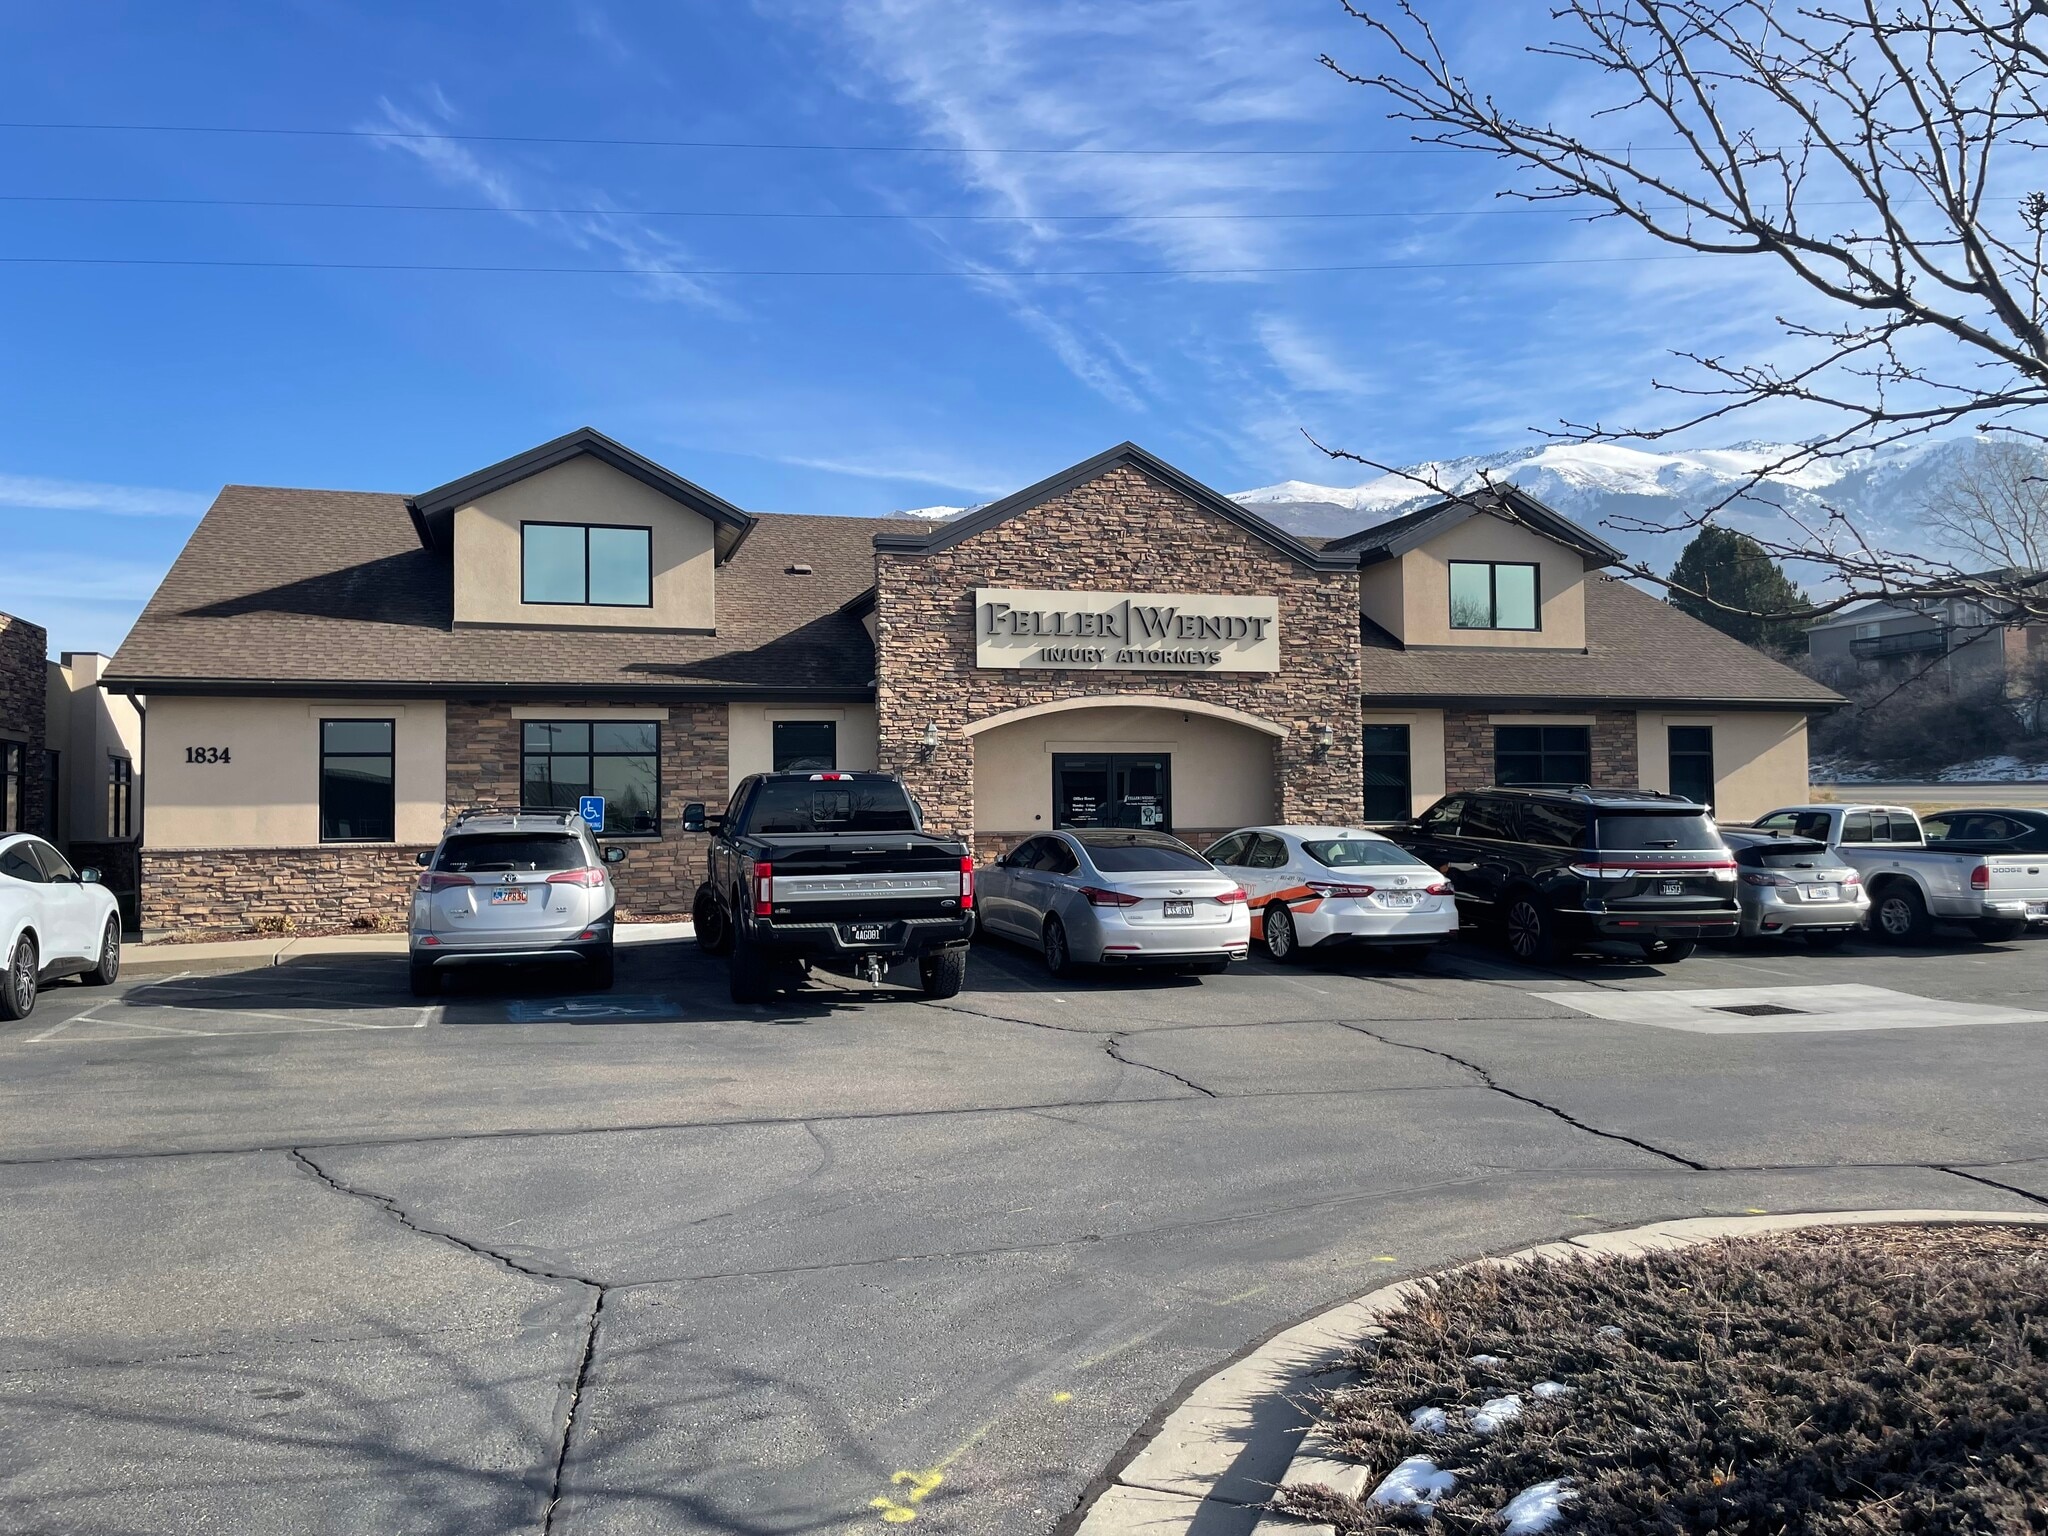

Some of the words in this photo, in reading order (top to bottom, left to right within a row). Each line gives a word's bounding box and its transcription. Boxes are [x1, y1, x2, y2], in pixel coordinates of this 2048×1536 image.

[987, 602, 1122, 638] FELLER
[1133, 606, 1272, 641] WENDT
[1042, 647, 1106, 663] INJURY
[1116, 648, 1222, 665] ATTORNEYS
[185, 746, 231, 764] 1834
[805, 880, 932, 890] PLATINUM
